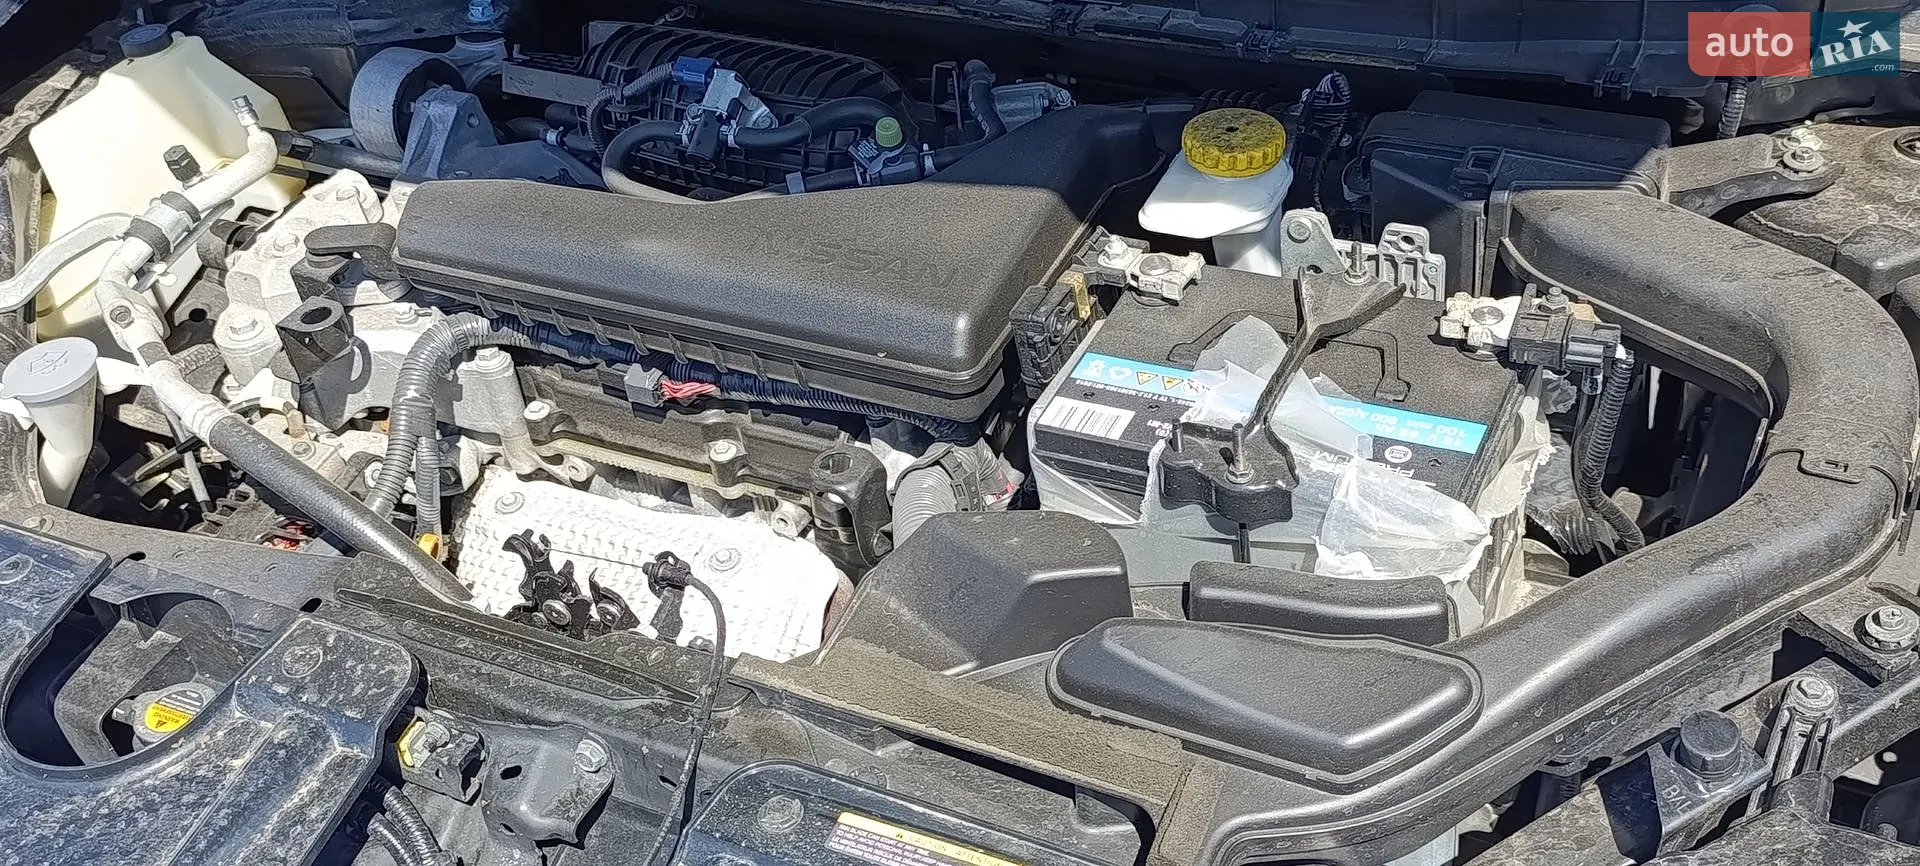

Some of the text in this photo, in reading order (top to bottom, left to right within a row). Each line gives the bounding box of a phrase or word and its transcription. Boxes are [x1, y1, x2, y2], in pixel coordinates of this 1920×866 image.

[1405, 418, 1433, 430] min
[1435, 424, 1465, 437] 100
[1427, 432, 1438, 442] V
[1441, 435, 1461, 446] 12
